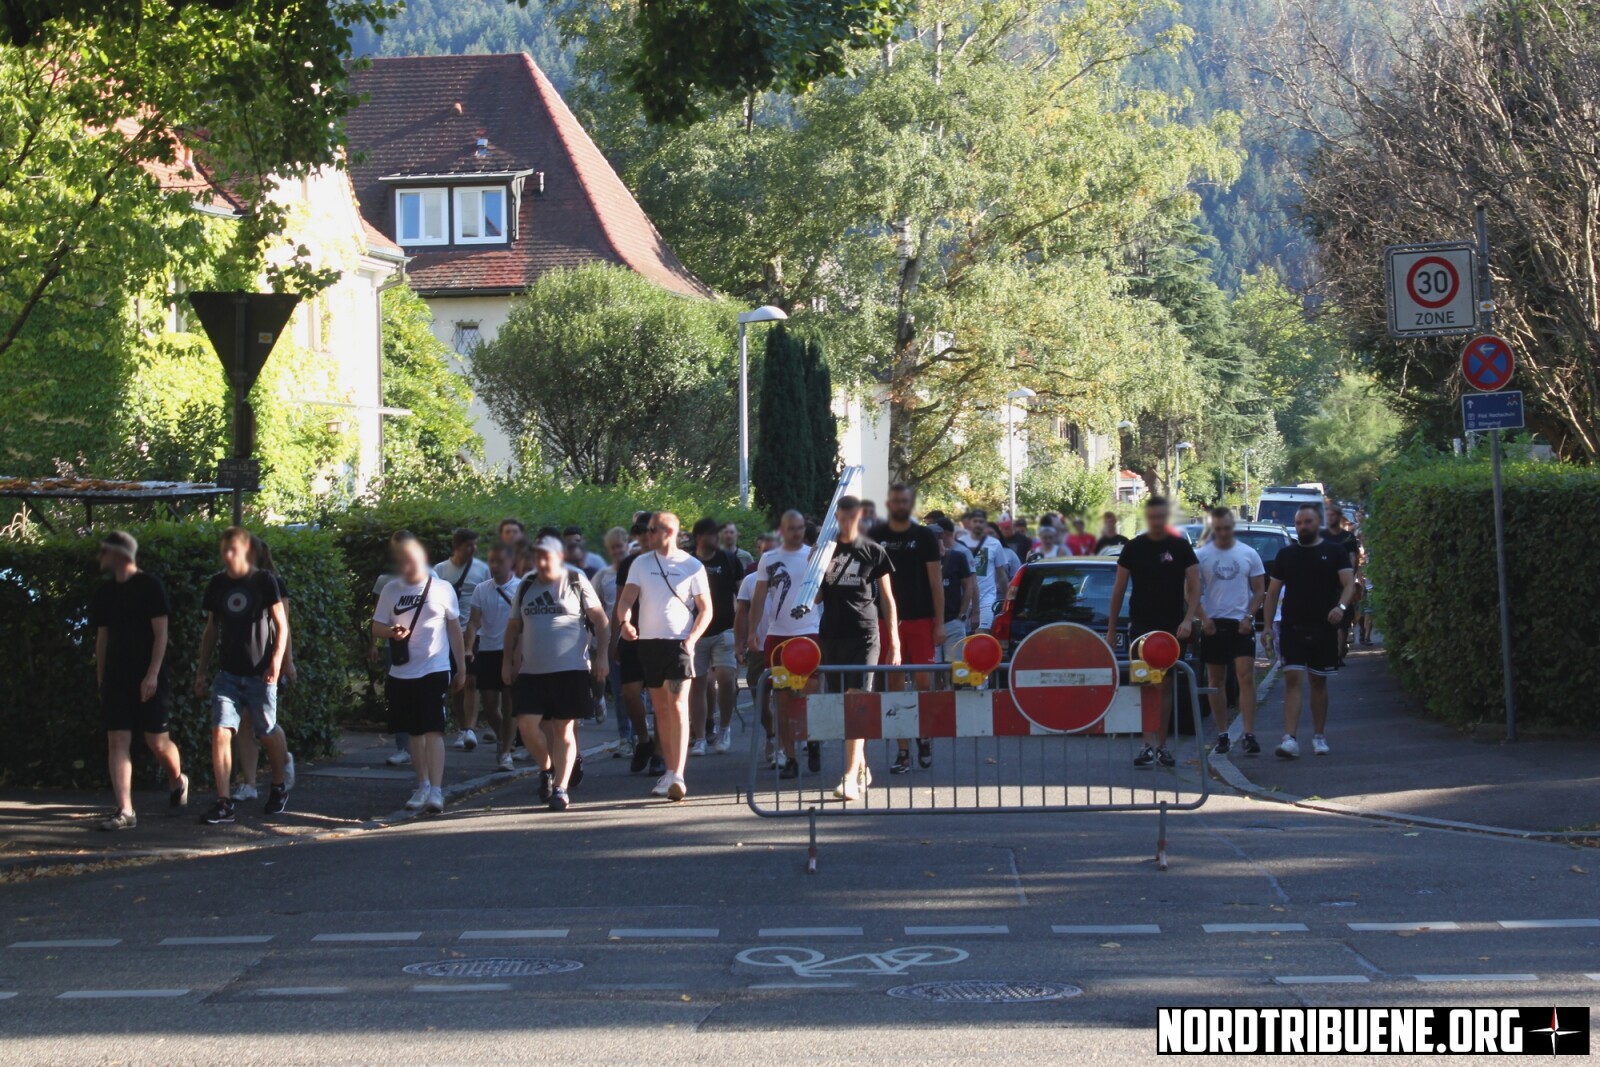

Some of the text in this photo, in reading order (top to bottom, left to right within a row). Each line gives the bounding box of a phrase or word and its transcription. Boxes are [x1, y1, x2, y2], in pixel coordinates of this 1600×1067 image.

[1417, 270, 1449, 295] 30
[1415, 310, 1456, 326] ZONE
[398, 594, 423, 607] NIKE
[523, 603, 563, 616] adidas
